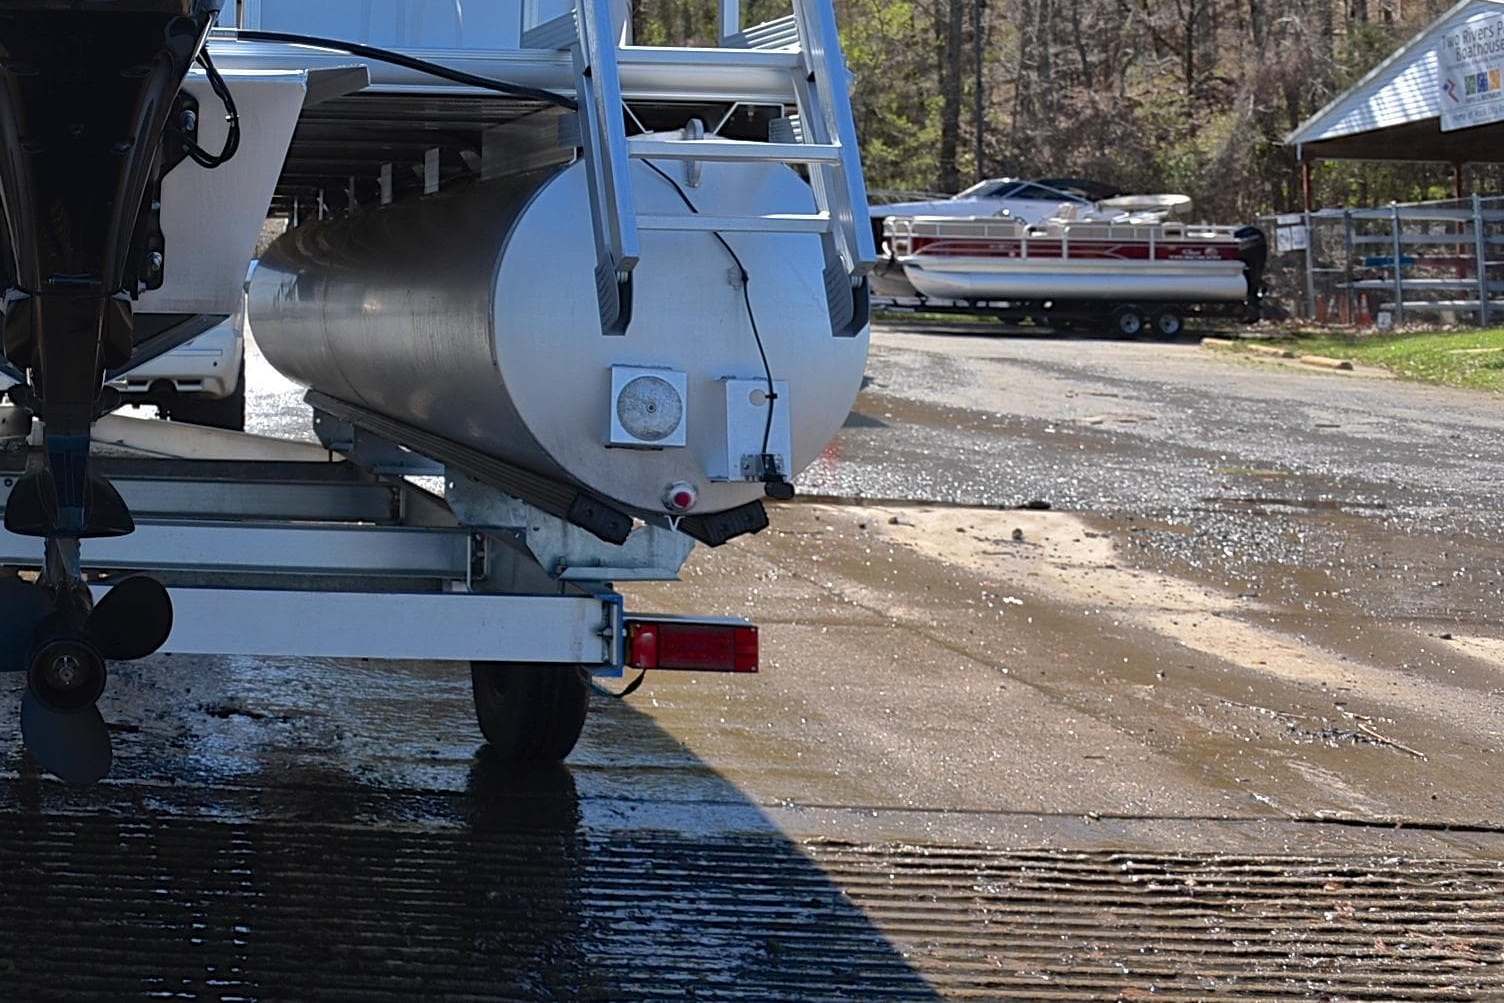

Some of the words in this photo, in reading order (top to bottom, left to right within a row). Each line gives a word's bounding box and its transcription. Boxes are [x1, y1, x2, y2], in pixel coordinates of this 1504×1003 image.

[1441, 34, 1460, 50] Two
[1462, 25, 1494, 44] Rivers
[1497, 20, 1504, 36] P
